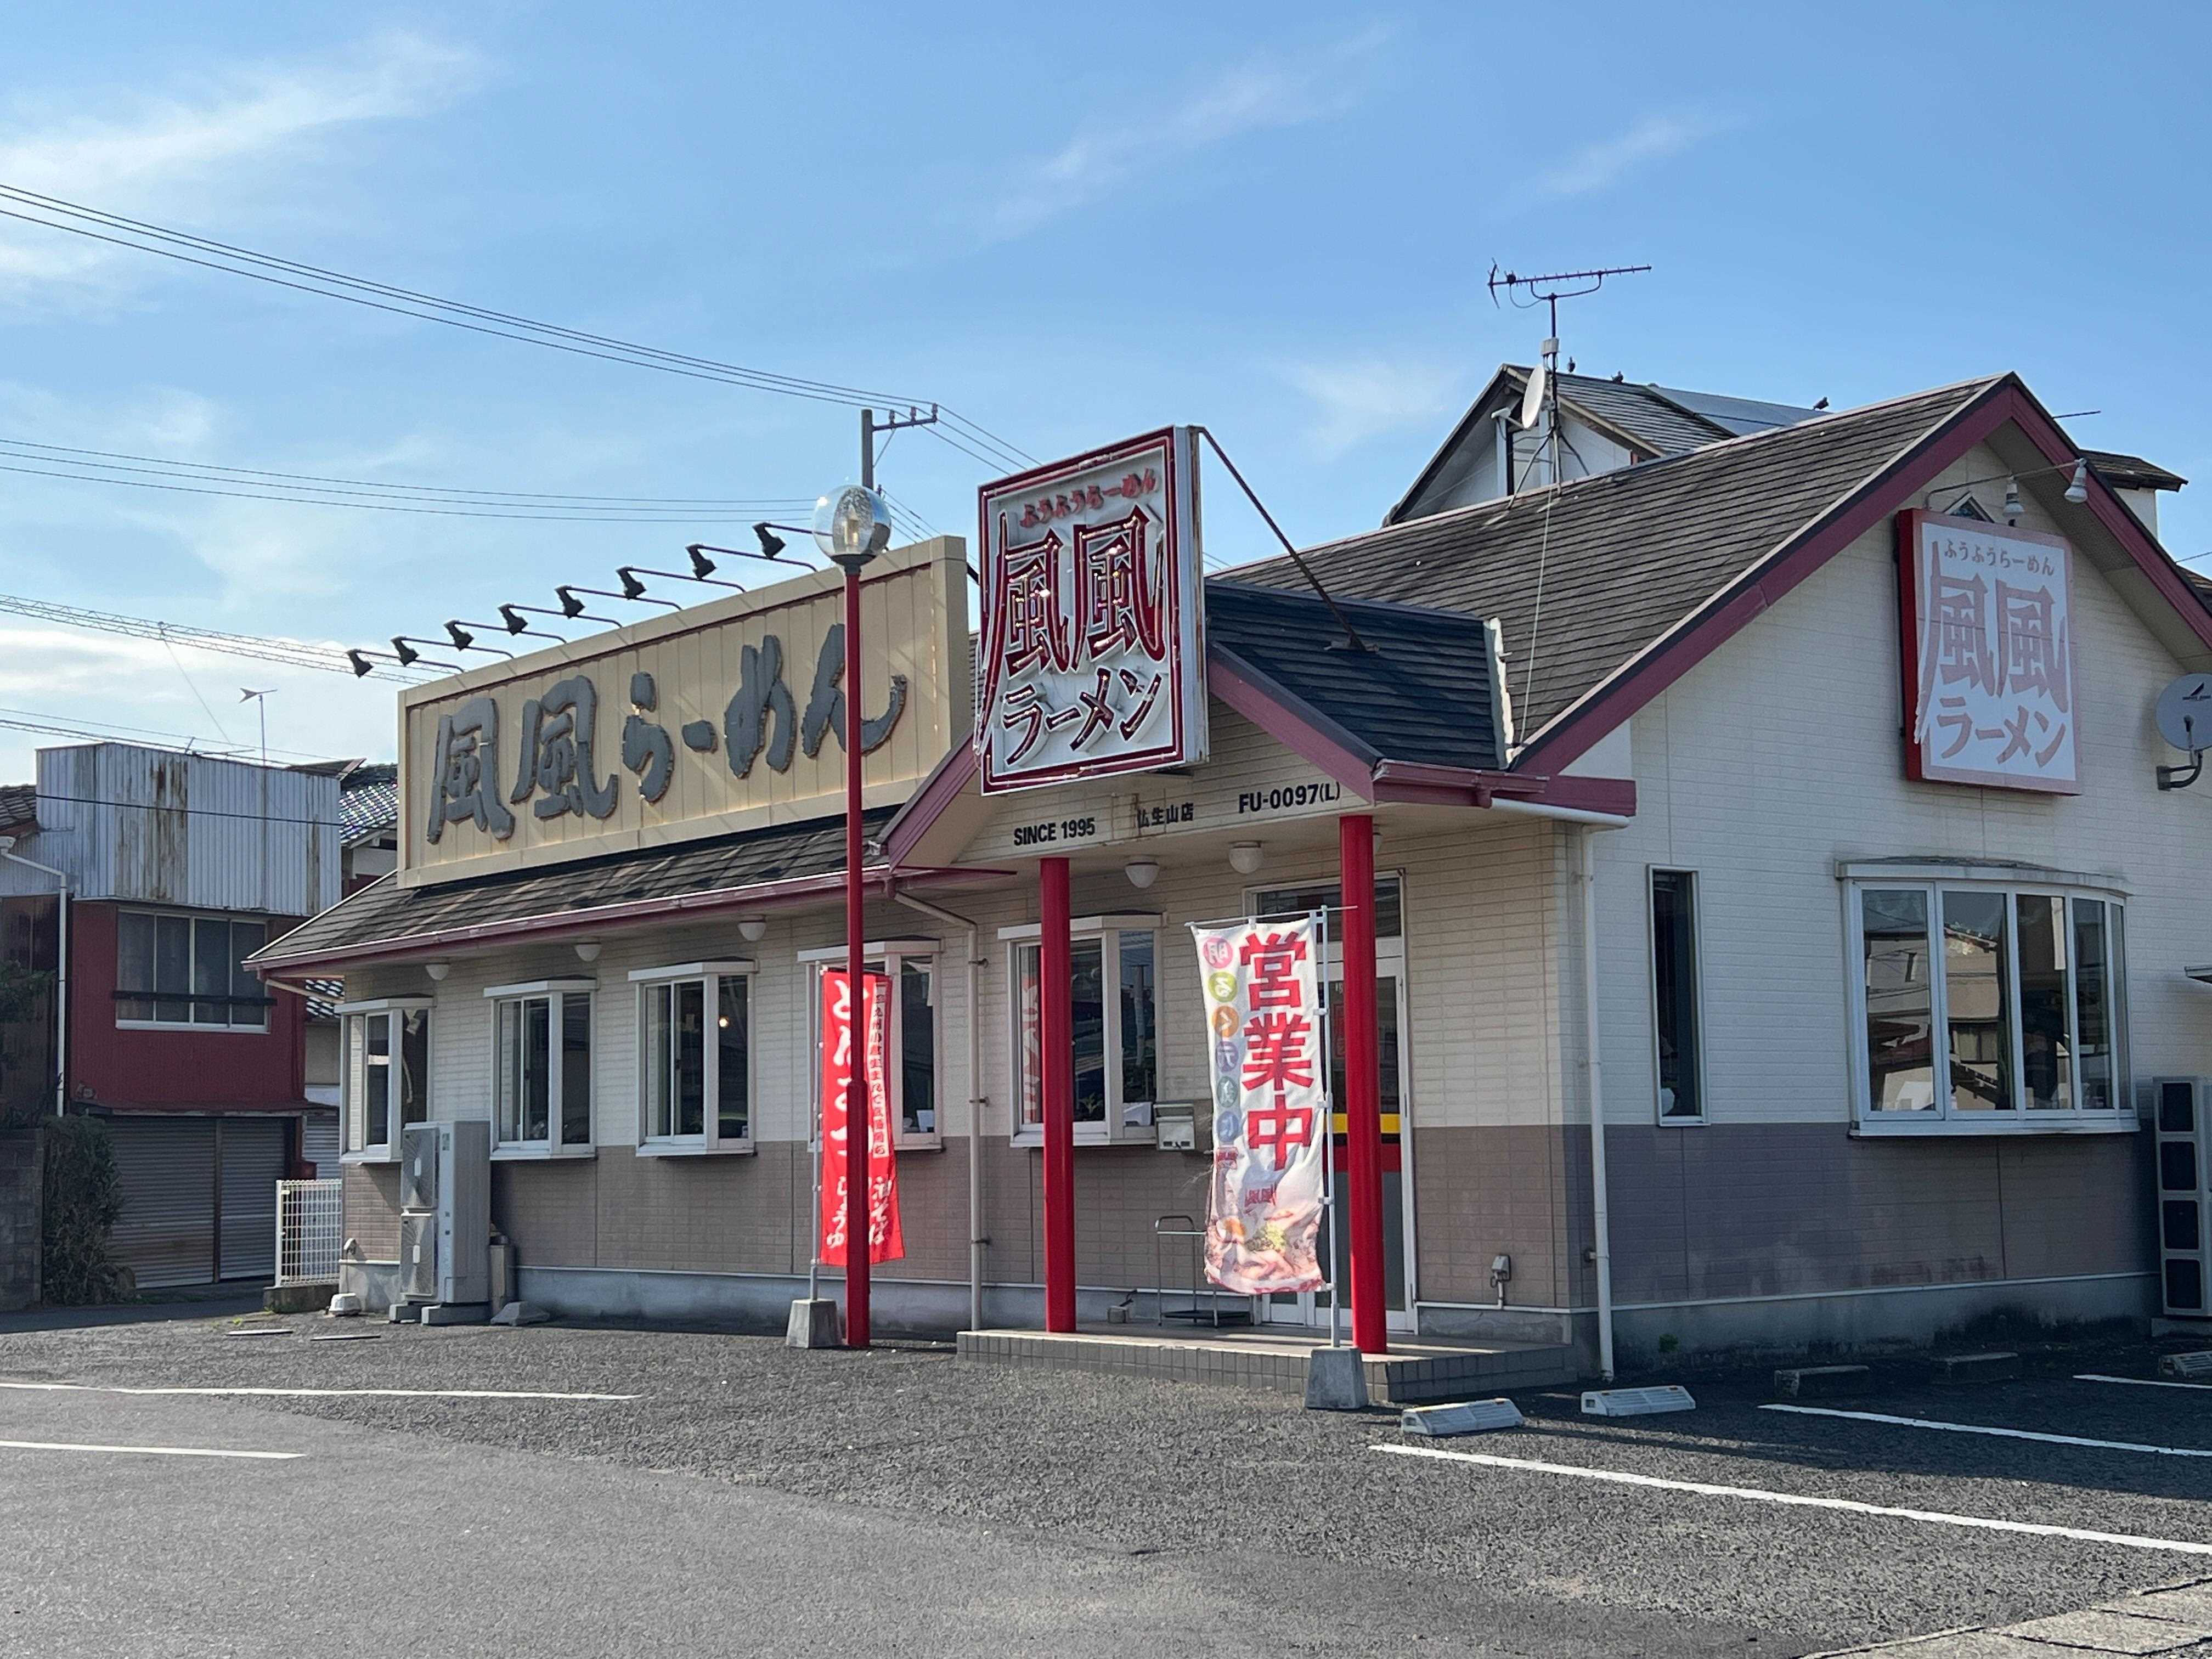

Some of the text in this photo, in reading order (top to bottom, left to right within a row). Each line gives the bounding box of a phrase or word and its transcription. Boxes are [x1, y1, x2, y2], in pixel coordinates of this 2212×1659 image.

[1944, 538, 2055, 576] ふうふうらーめん
[975, 504, 1166, 747] 風風
[1915, 541, 2069, 745] 風風
[426, 623, 908, 845] 風風らーめん
[1003, 668, 1163, 765] ラーメン
[1937, 697, 2066, 768] ラーメン
[1014, 817, 1095, 846] SINCE 1995
[1239, 782, 1340, 814] FU-0097(L)
